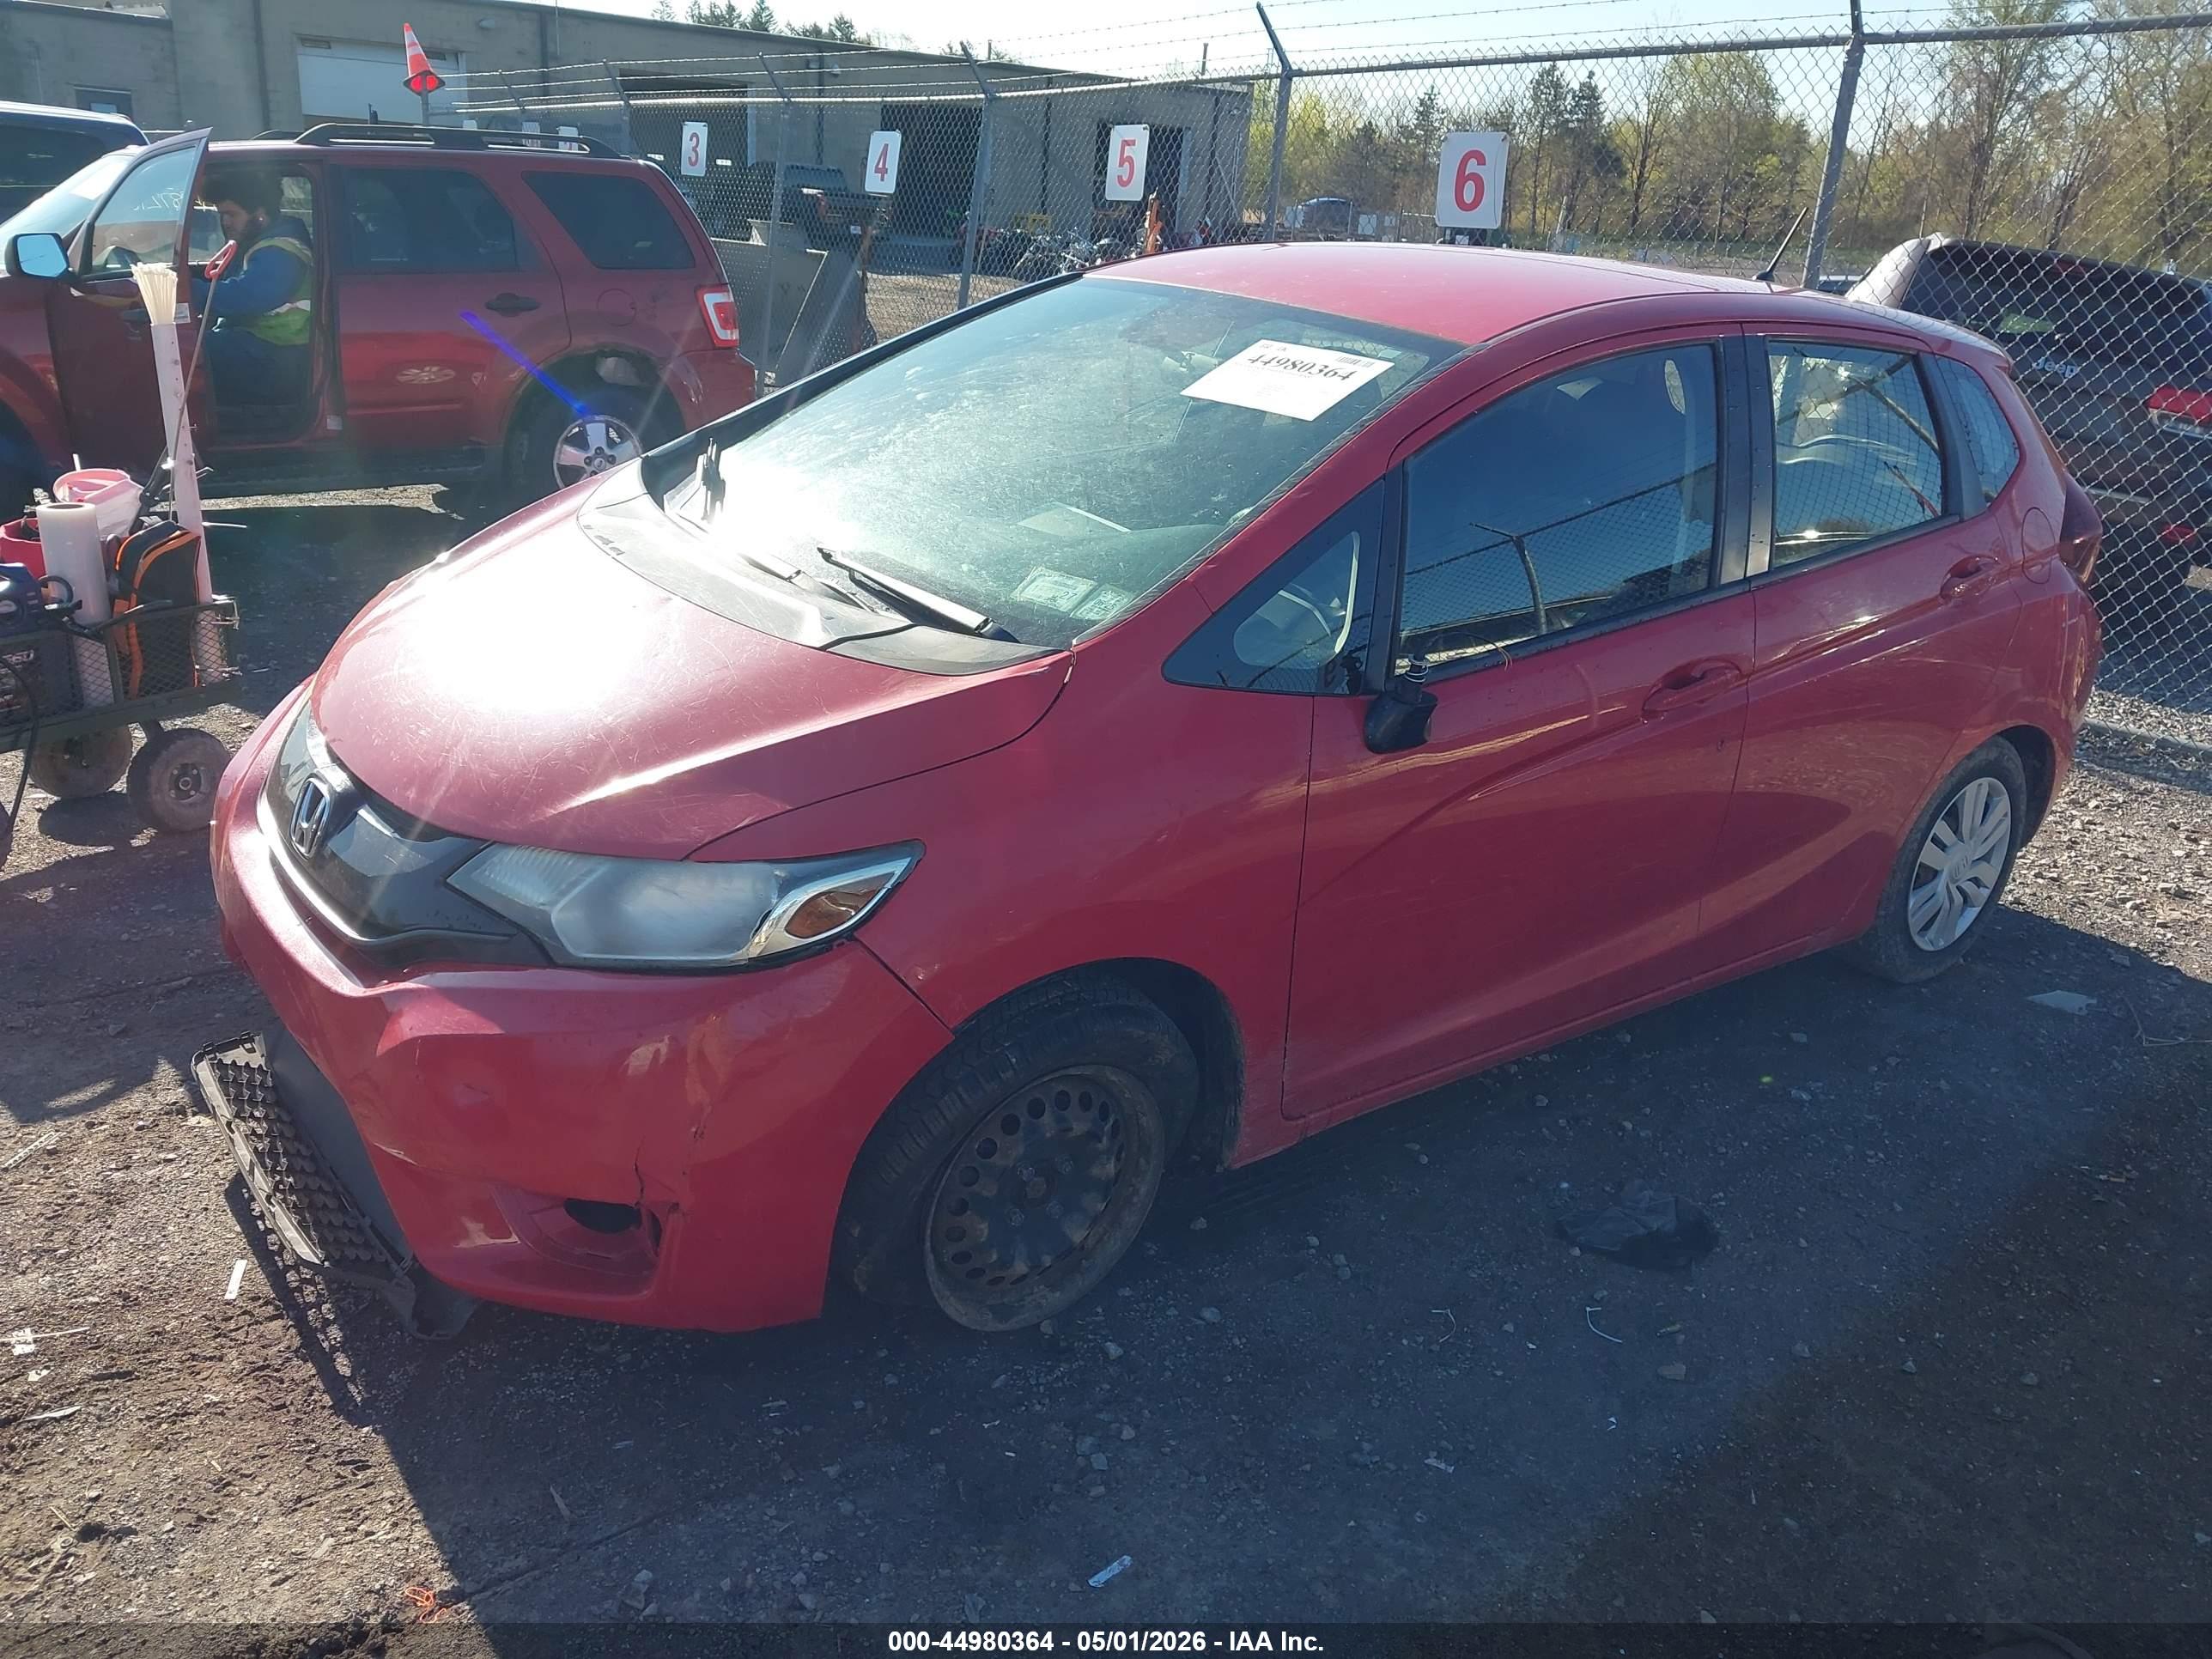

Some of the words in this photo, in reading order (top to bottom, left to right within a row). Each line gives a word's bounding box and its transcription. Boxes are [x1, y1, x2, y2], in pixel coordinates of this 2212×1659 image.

[687, 131, 700, 167] 3
[873, 143, 889, 182] 4
[1115, 137, 1137, 188] 5
[1454, 149, 1486, 212] 6
[1247, 353, 1358, 381] 44980364
[2032, 356, 2076, 379] Jeep
